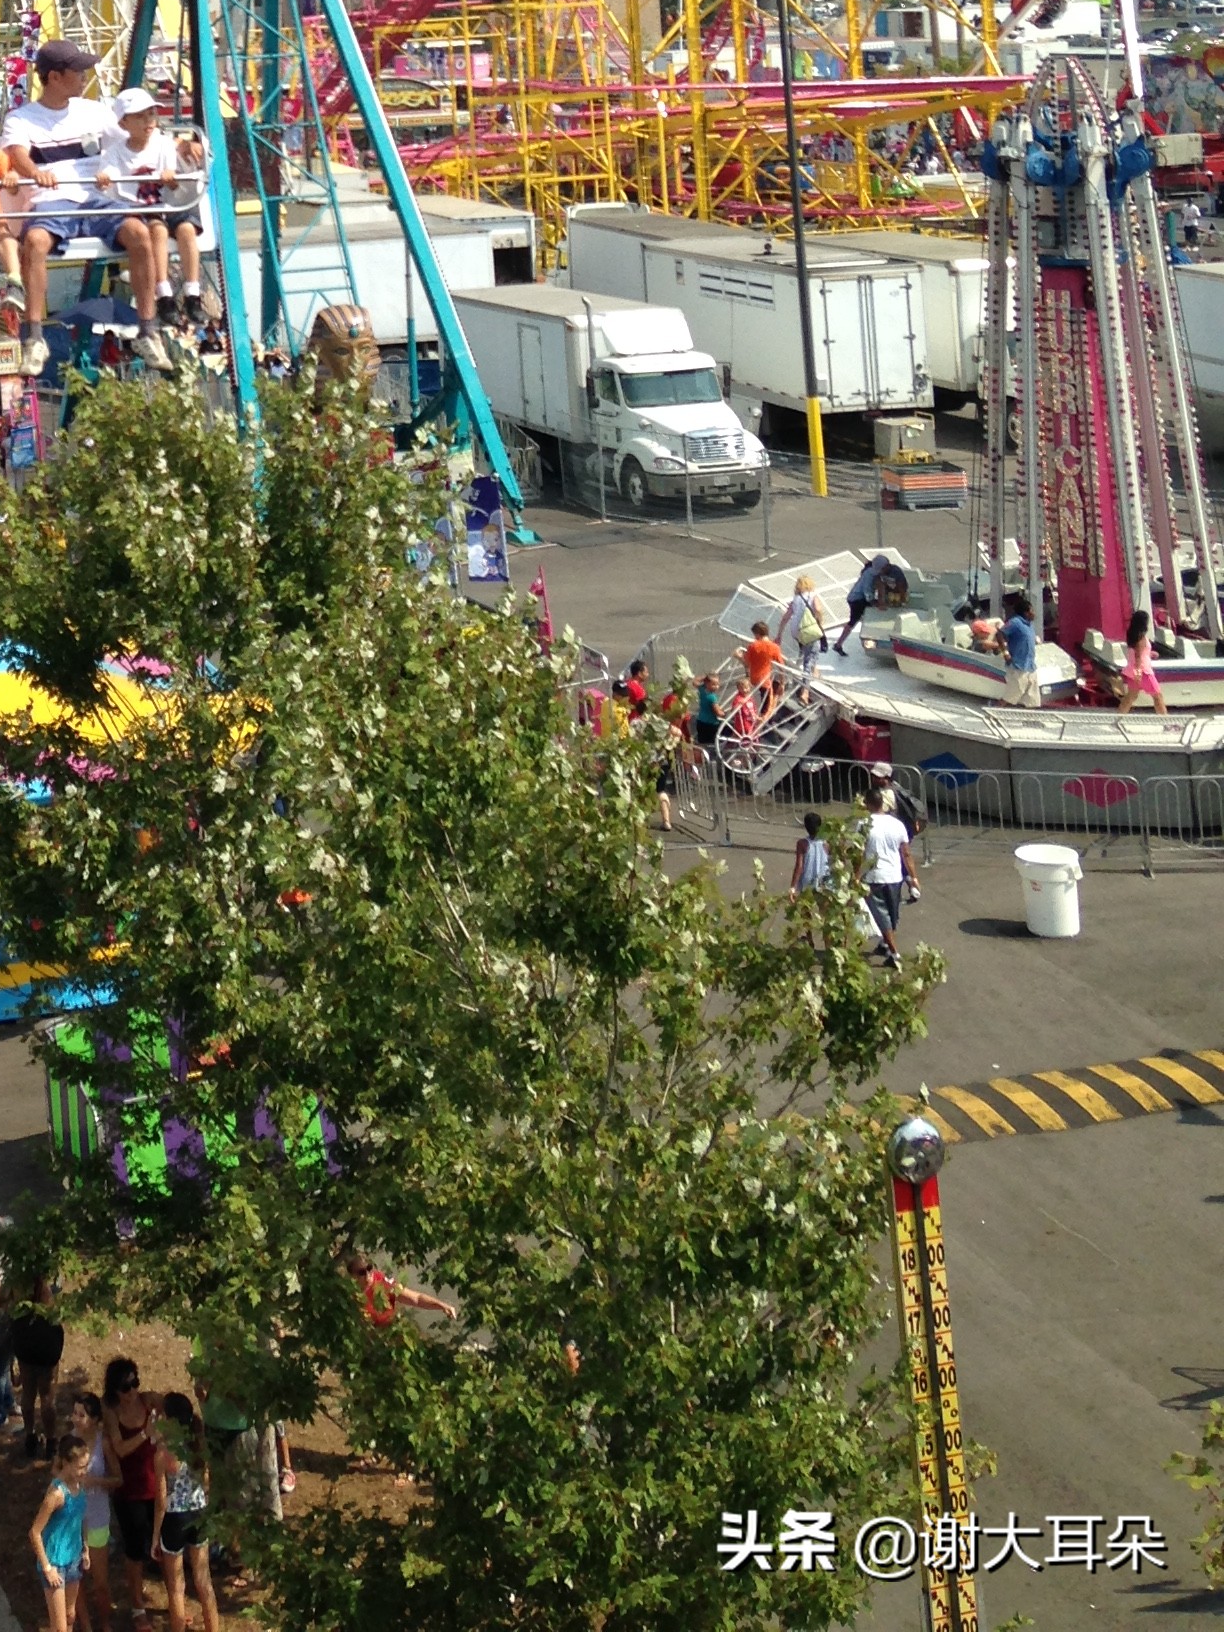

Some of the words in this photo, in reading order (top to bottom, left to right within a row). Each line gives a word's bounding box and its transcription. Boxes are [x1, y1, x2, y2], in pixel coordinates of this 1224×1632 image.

[1045, 288, 1086, 569] HURRICANE
[901, 1248, 916, 1272] 18
[927, 1243, 945, 1266] 00
[908, 1311, 921, 1335] 17
[933, 1305, 951, 1329] 00
[914, 1371, 927, 1394] 16
[939, 1365, 957, 1389] 00
[945, 1428, 962, 1452] 00
[950, 1490, 968, 1513] 00
